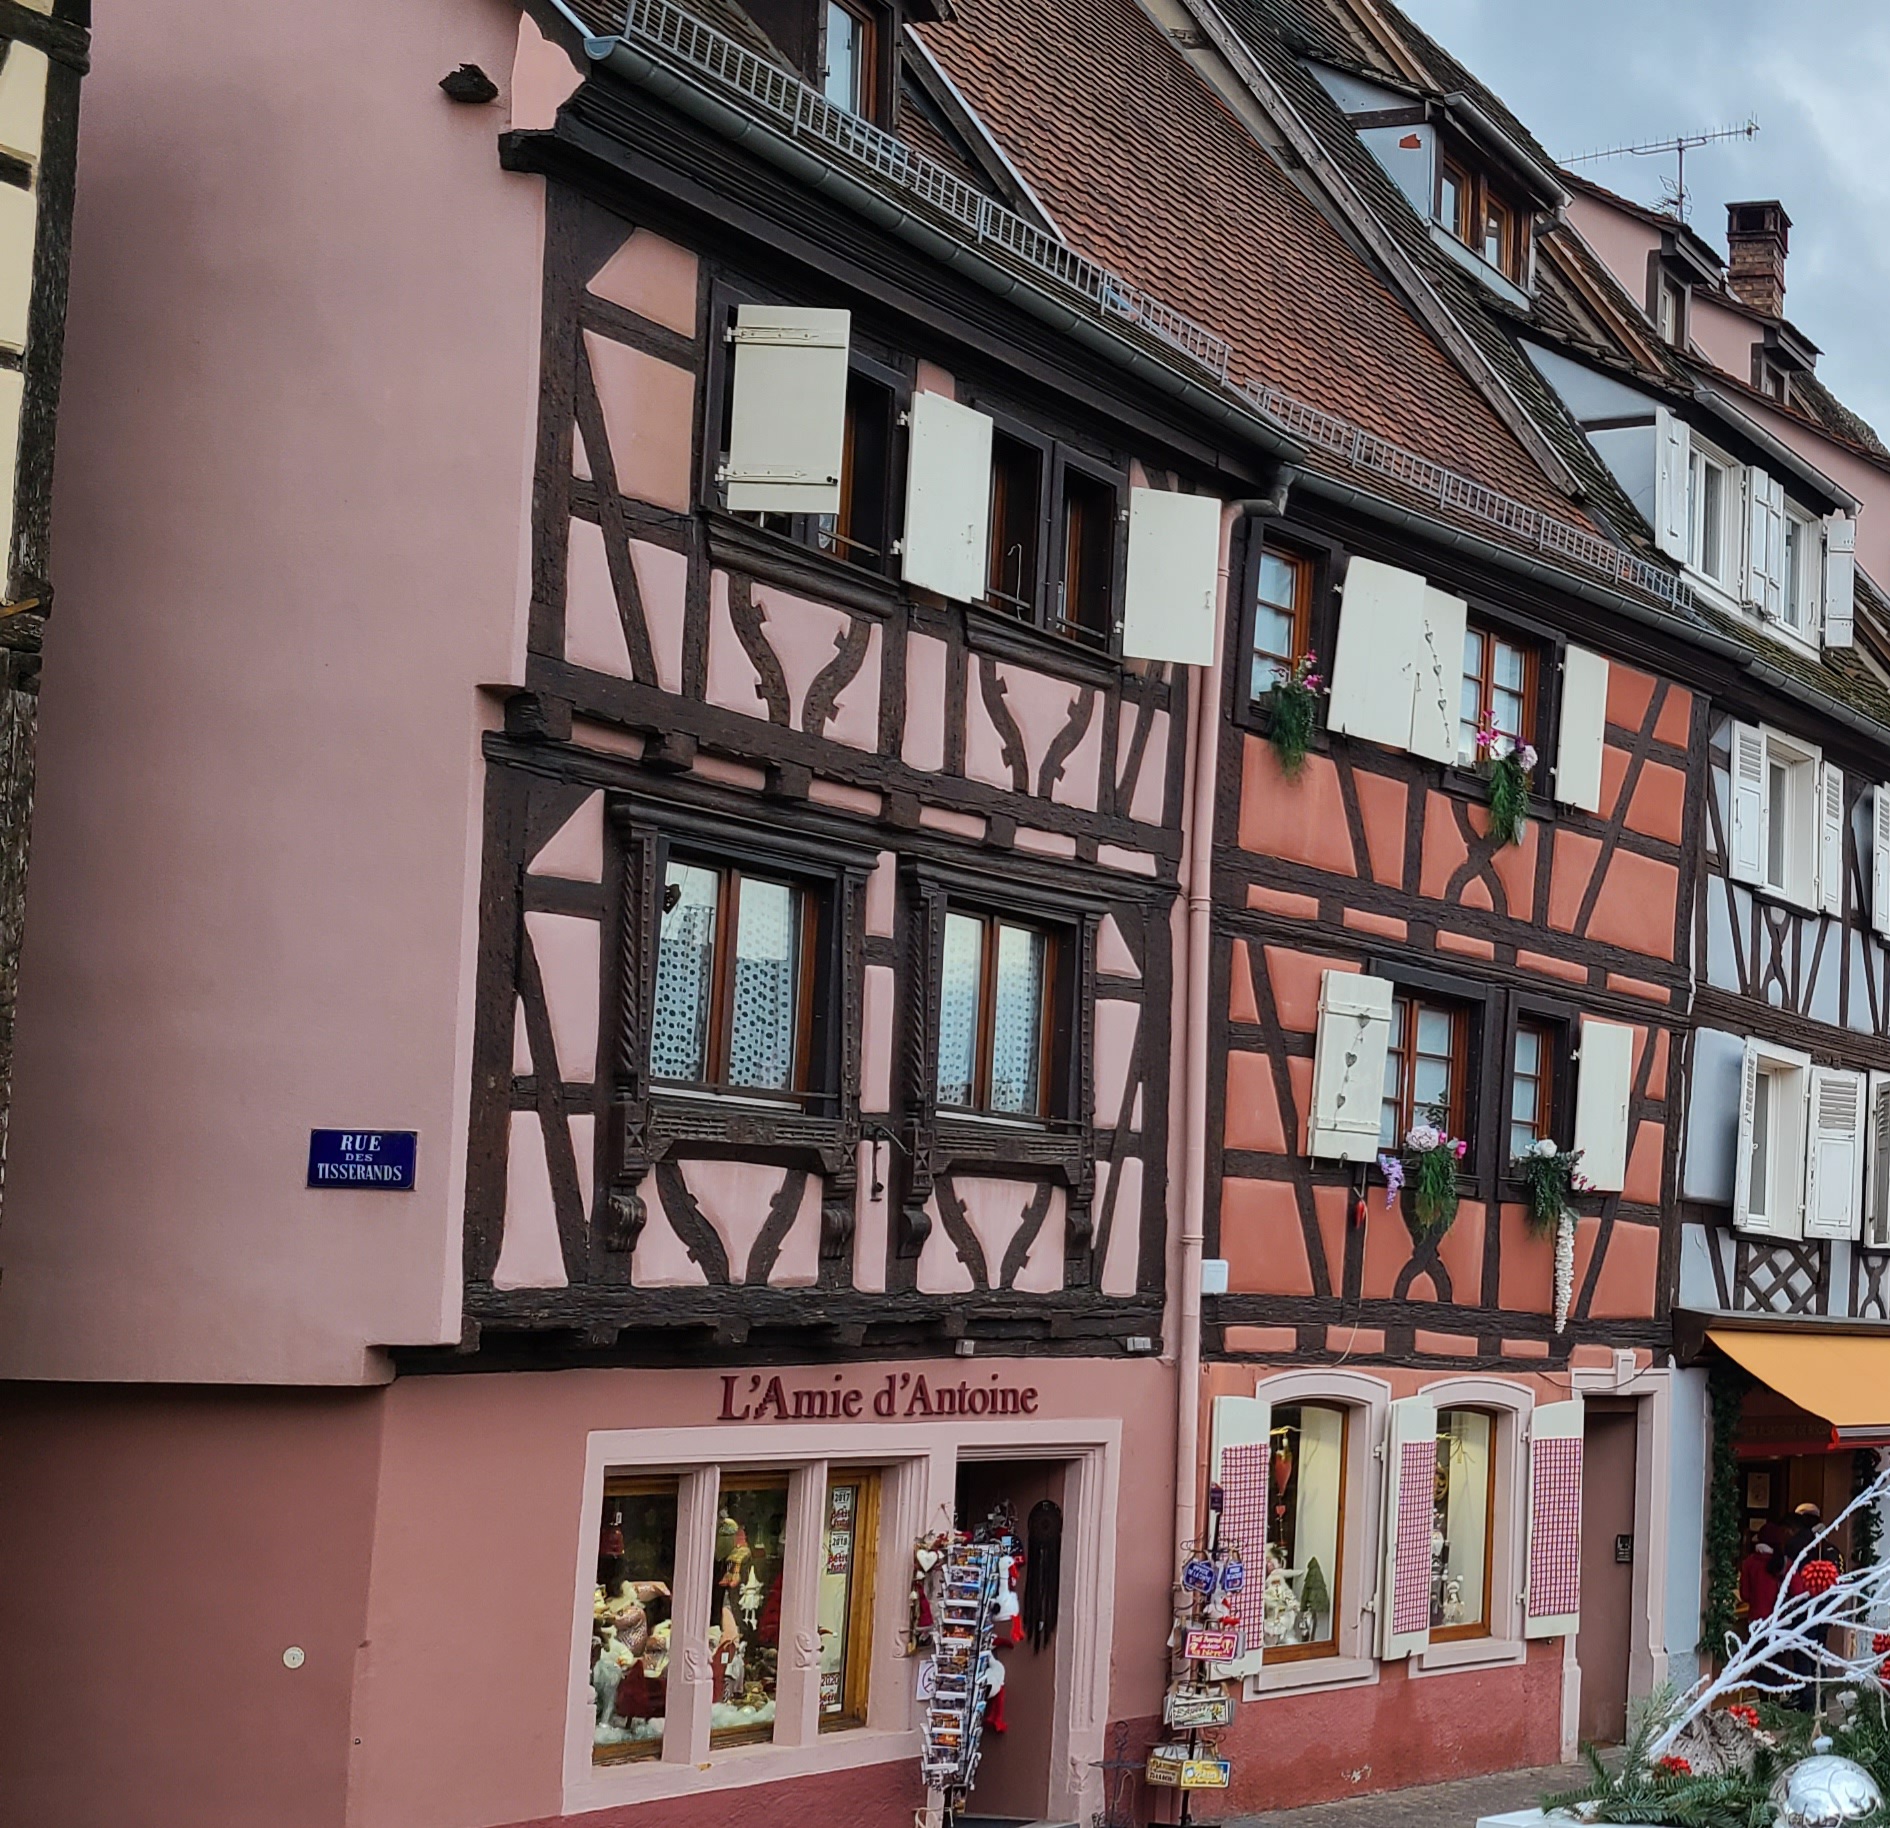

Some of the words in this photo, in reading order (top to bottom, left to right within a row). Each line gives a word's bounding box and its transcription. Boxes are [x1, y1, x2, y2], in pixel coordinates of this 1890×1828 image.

[340, 1134, 382, 1151] RUE
[345, 1153, 373, 1162] DES
[317, 1163, 402, 1181] TISSERANDS
[717, 1373, 863, 1420] L'Amie
[873, 1372, 1039, 1417] d'Antoine
[834, 1493, 850, 1502] 2017
